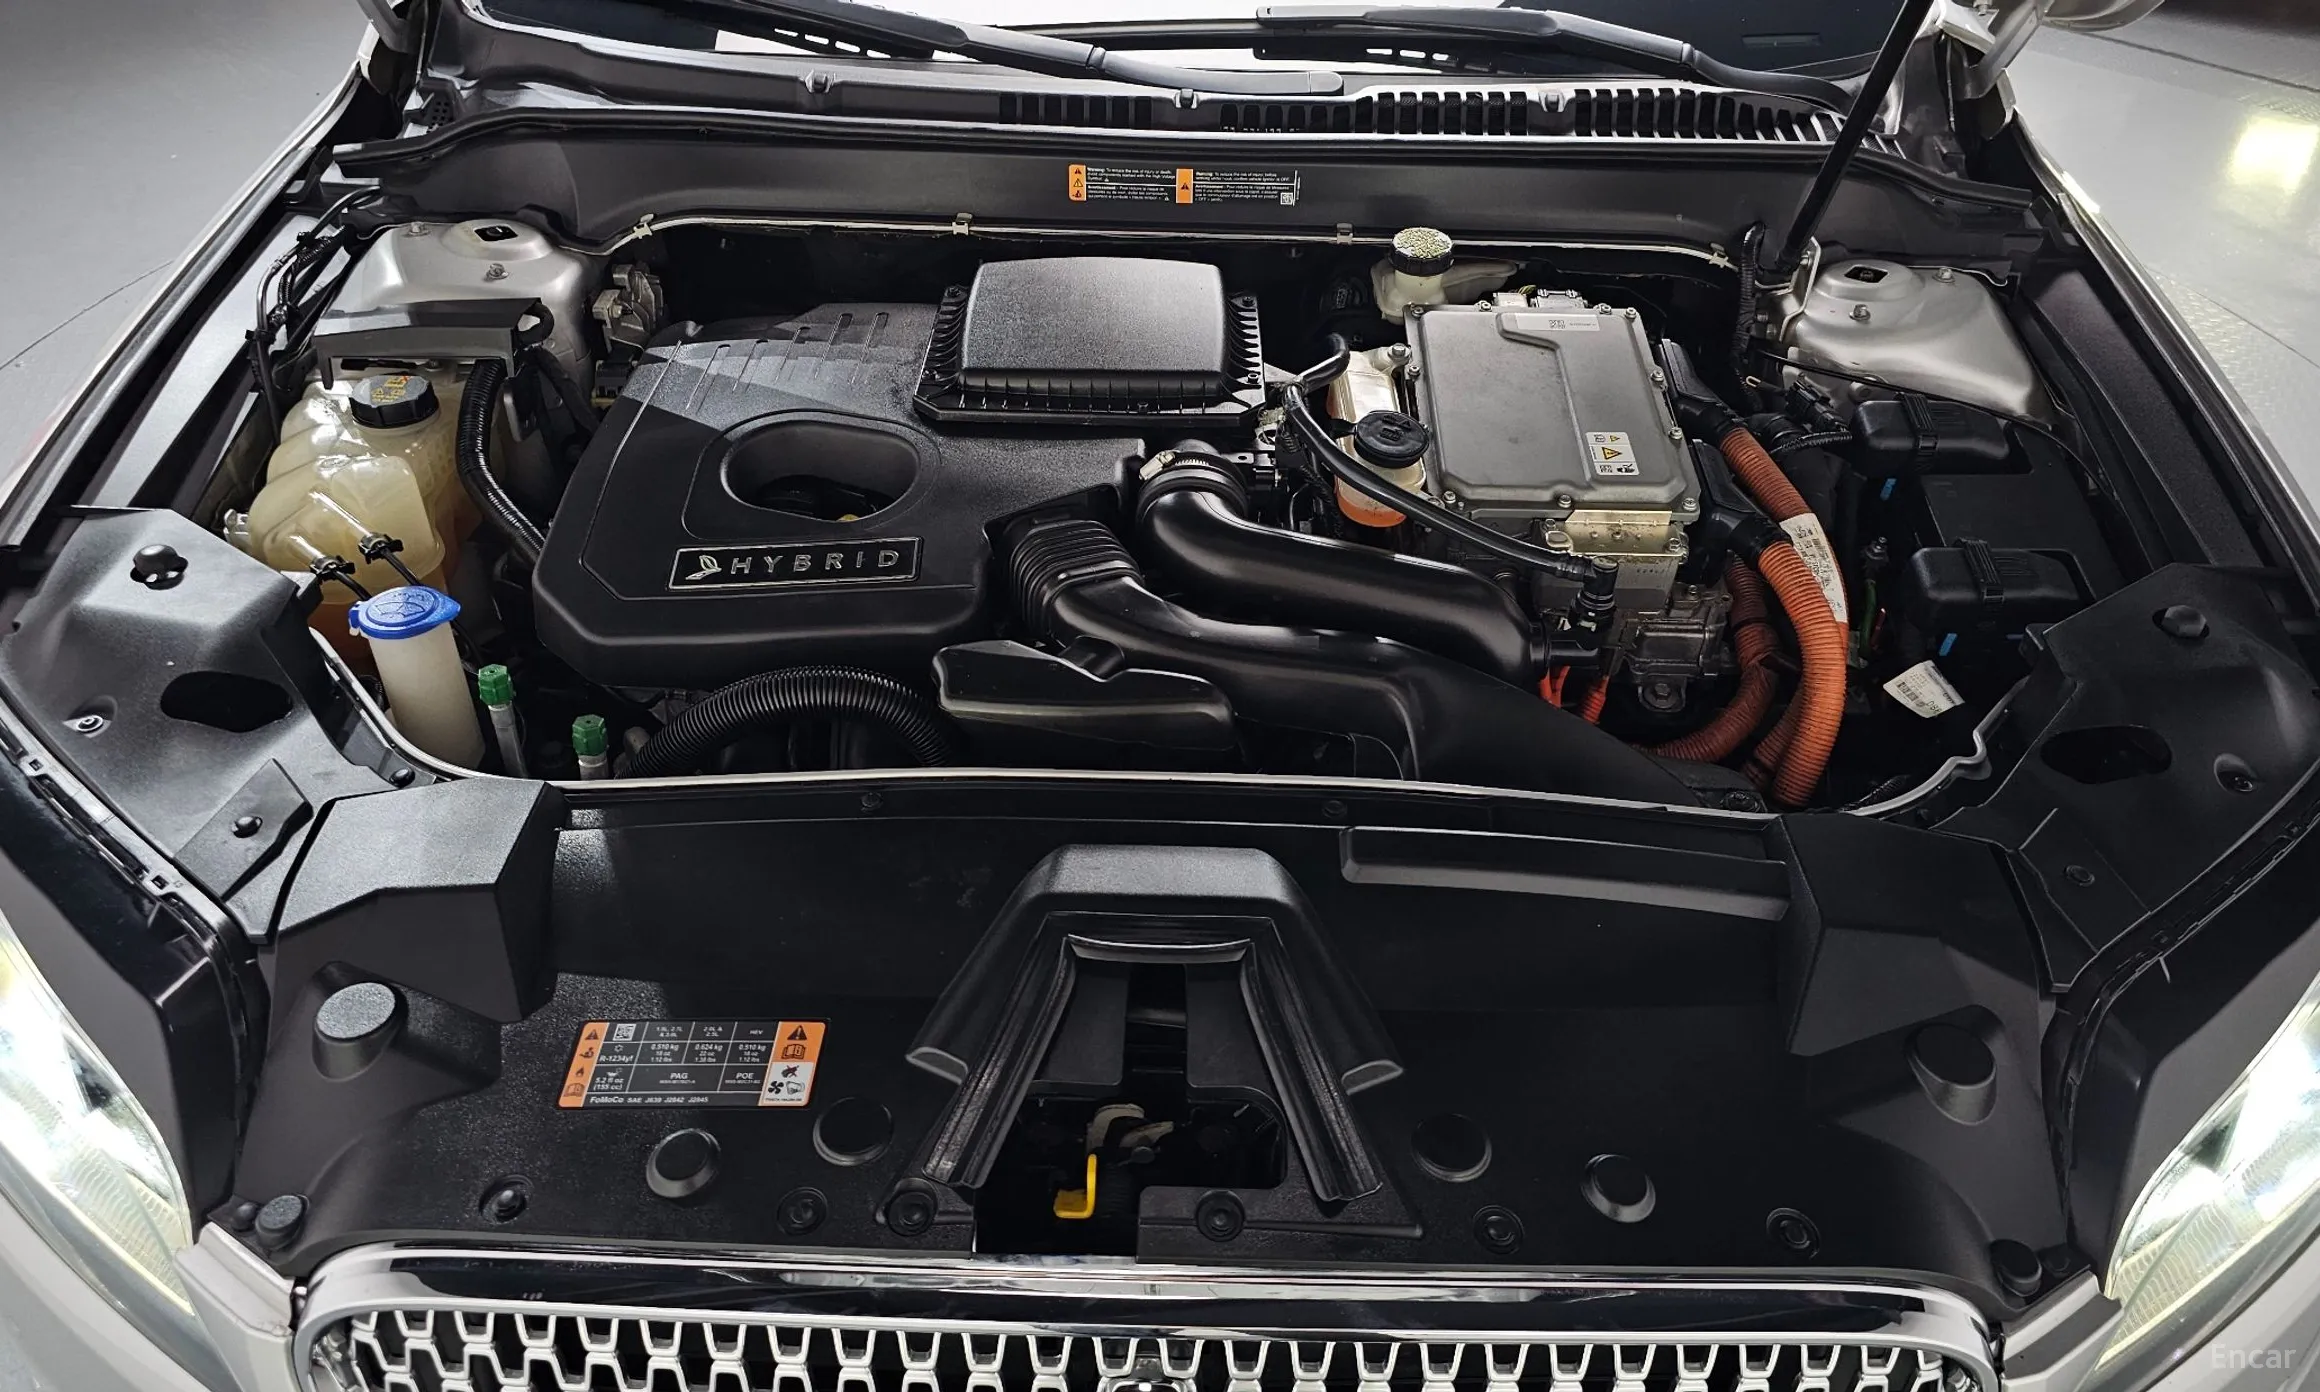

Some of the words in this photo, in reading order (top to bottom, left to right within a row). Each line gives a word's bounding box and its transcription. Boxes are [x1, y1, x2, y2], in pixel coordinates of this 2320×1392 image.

[730, 549, 900, 575] HYBRID
[669, 1043, 680, 1052] kg
[713, 1044, 723, 1052] kg
[757, 1044, 767, 1052] kg
[599, 1054, 634, 1063] R-1234yf
[669, 1072, 689, 1080] PAG
[735, 1072, 755, 1080] POE
[589, 1096, 625, 1104] FoMoCo
